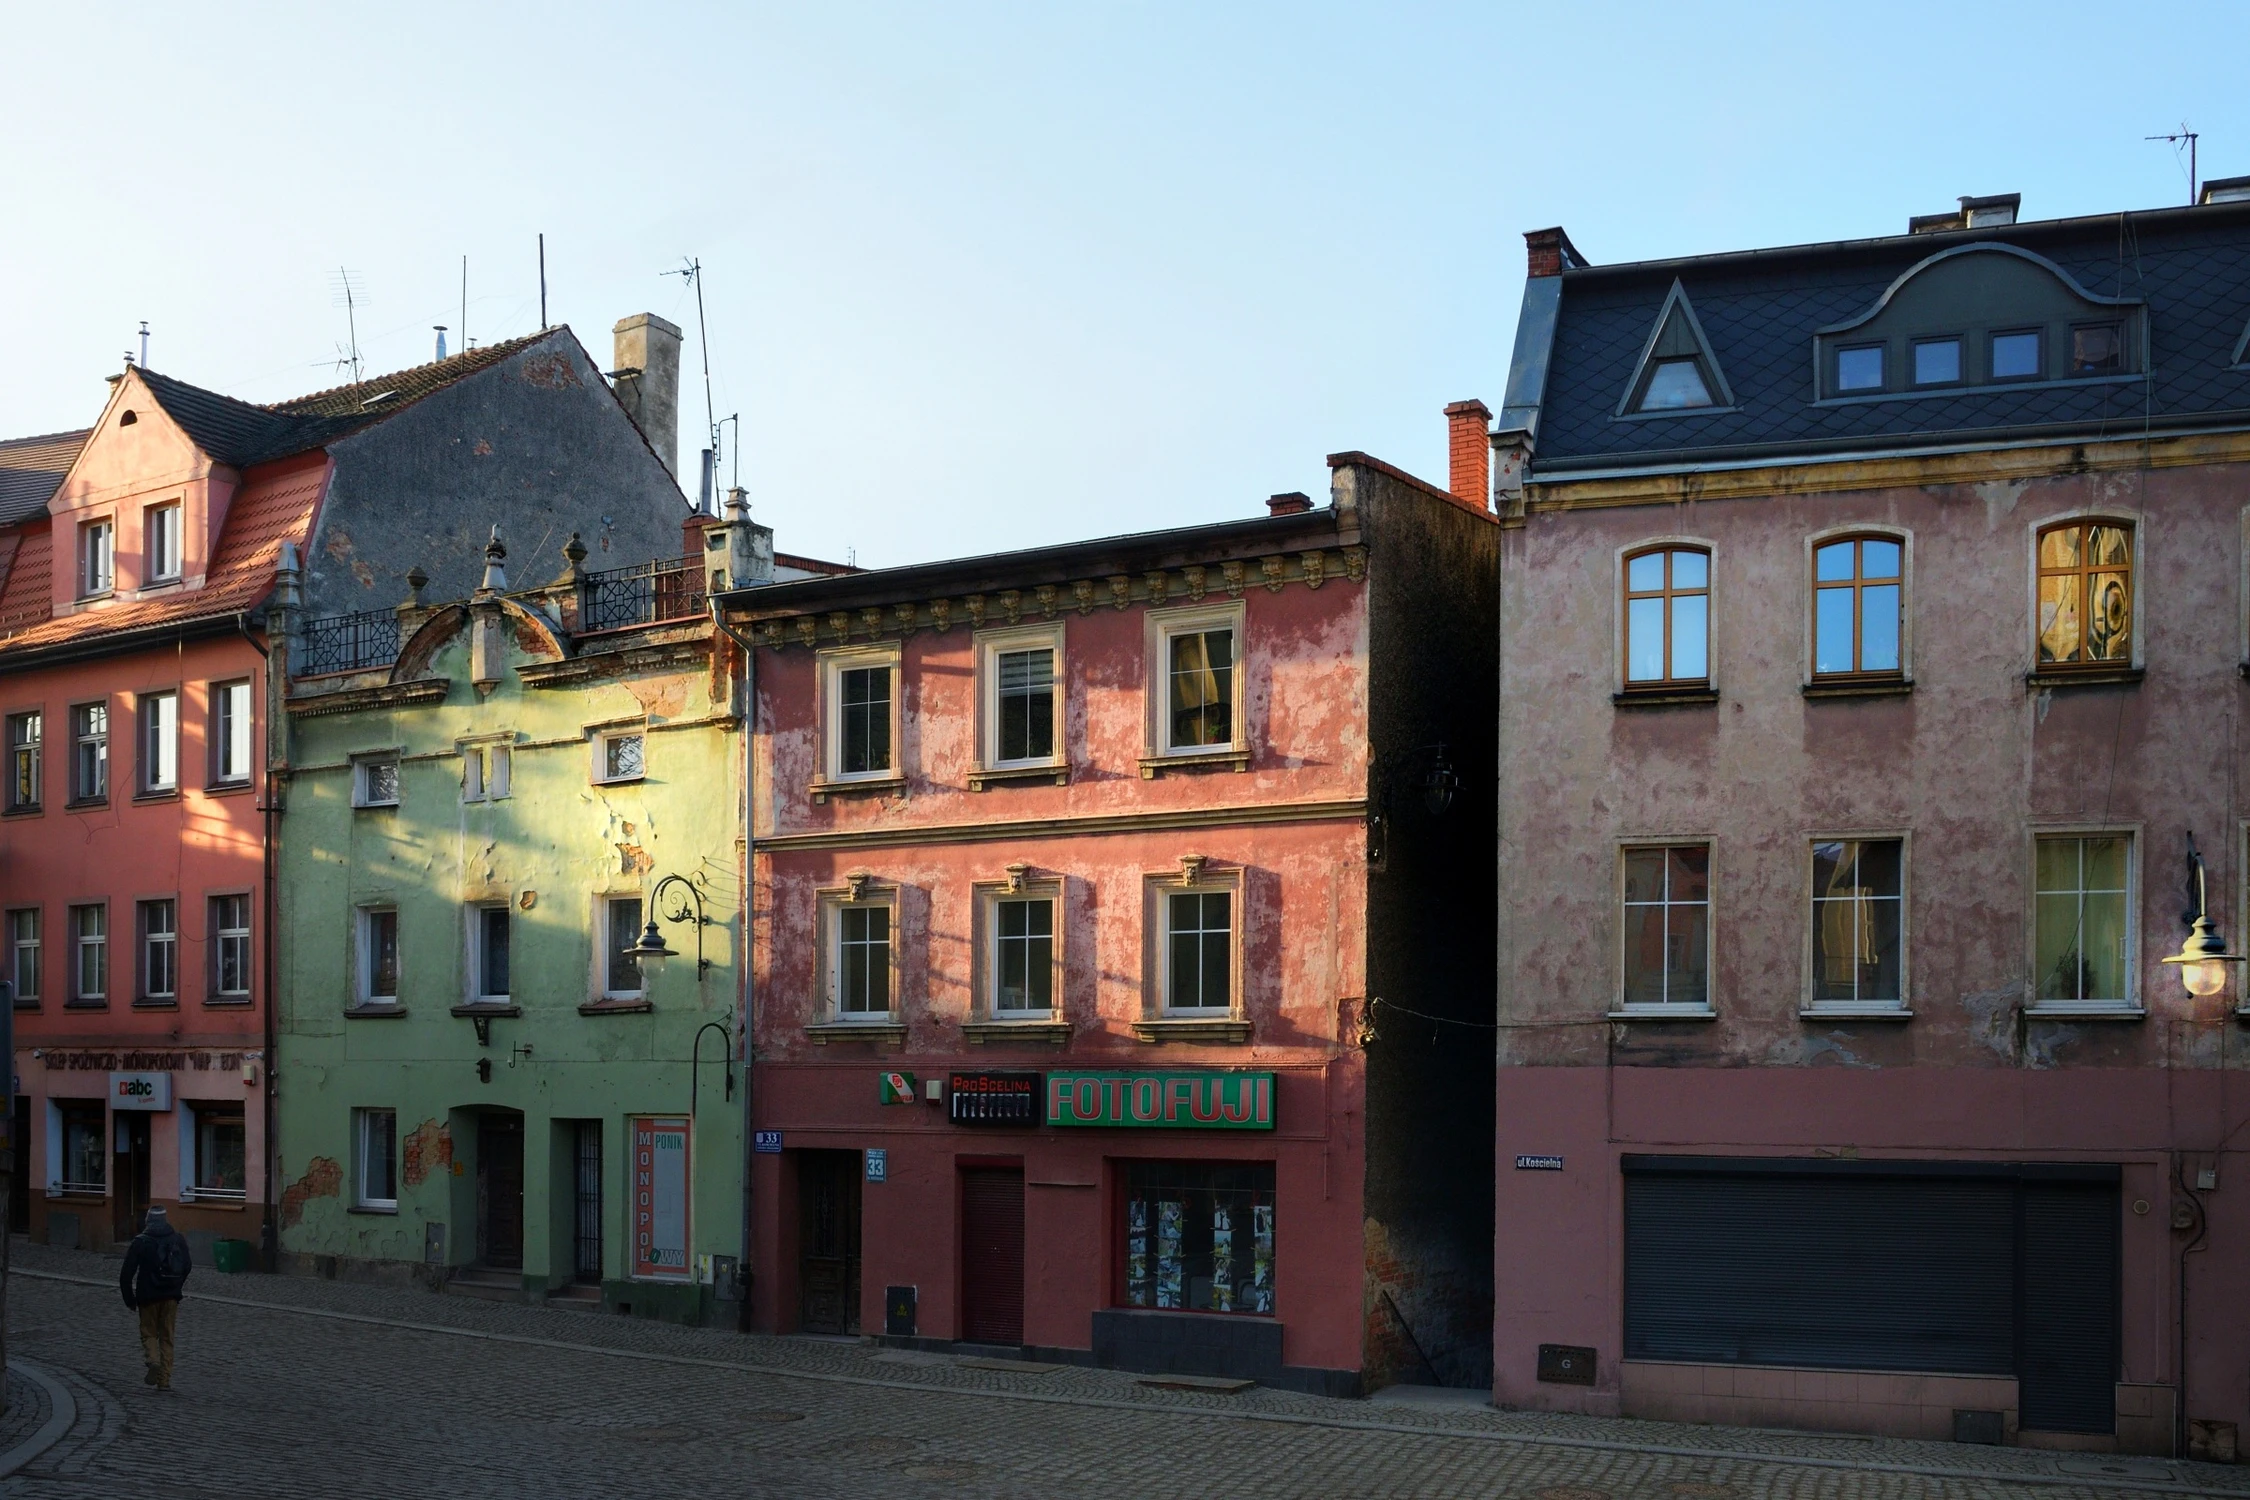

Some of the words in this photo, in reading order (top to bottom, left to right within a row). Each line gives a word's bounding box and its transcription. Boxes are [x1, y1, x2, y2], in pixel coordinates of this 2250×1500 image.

[45, 1053, 66, 1070] SKLEP
[128, 1079, 152, 1095] abc
[1049, 1077, 1269, 1123] FOTOFUJI
[765, 1132, 778, 1144] 33
[868, 1159, 884, 1175] 33
[1561, 1359, 1571, 1369] G
